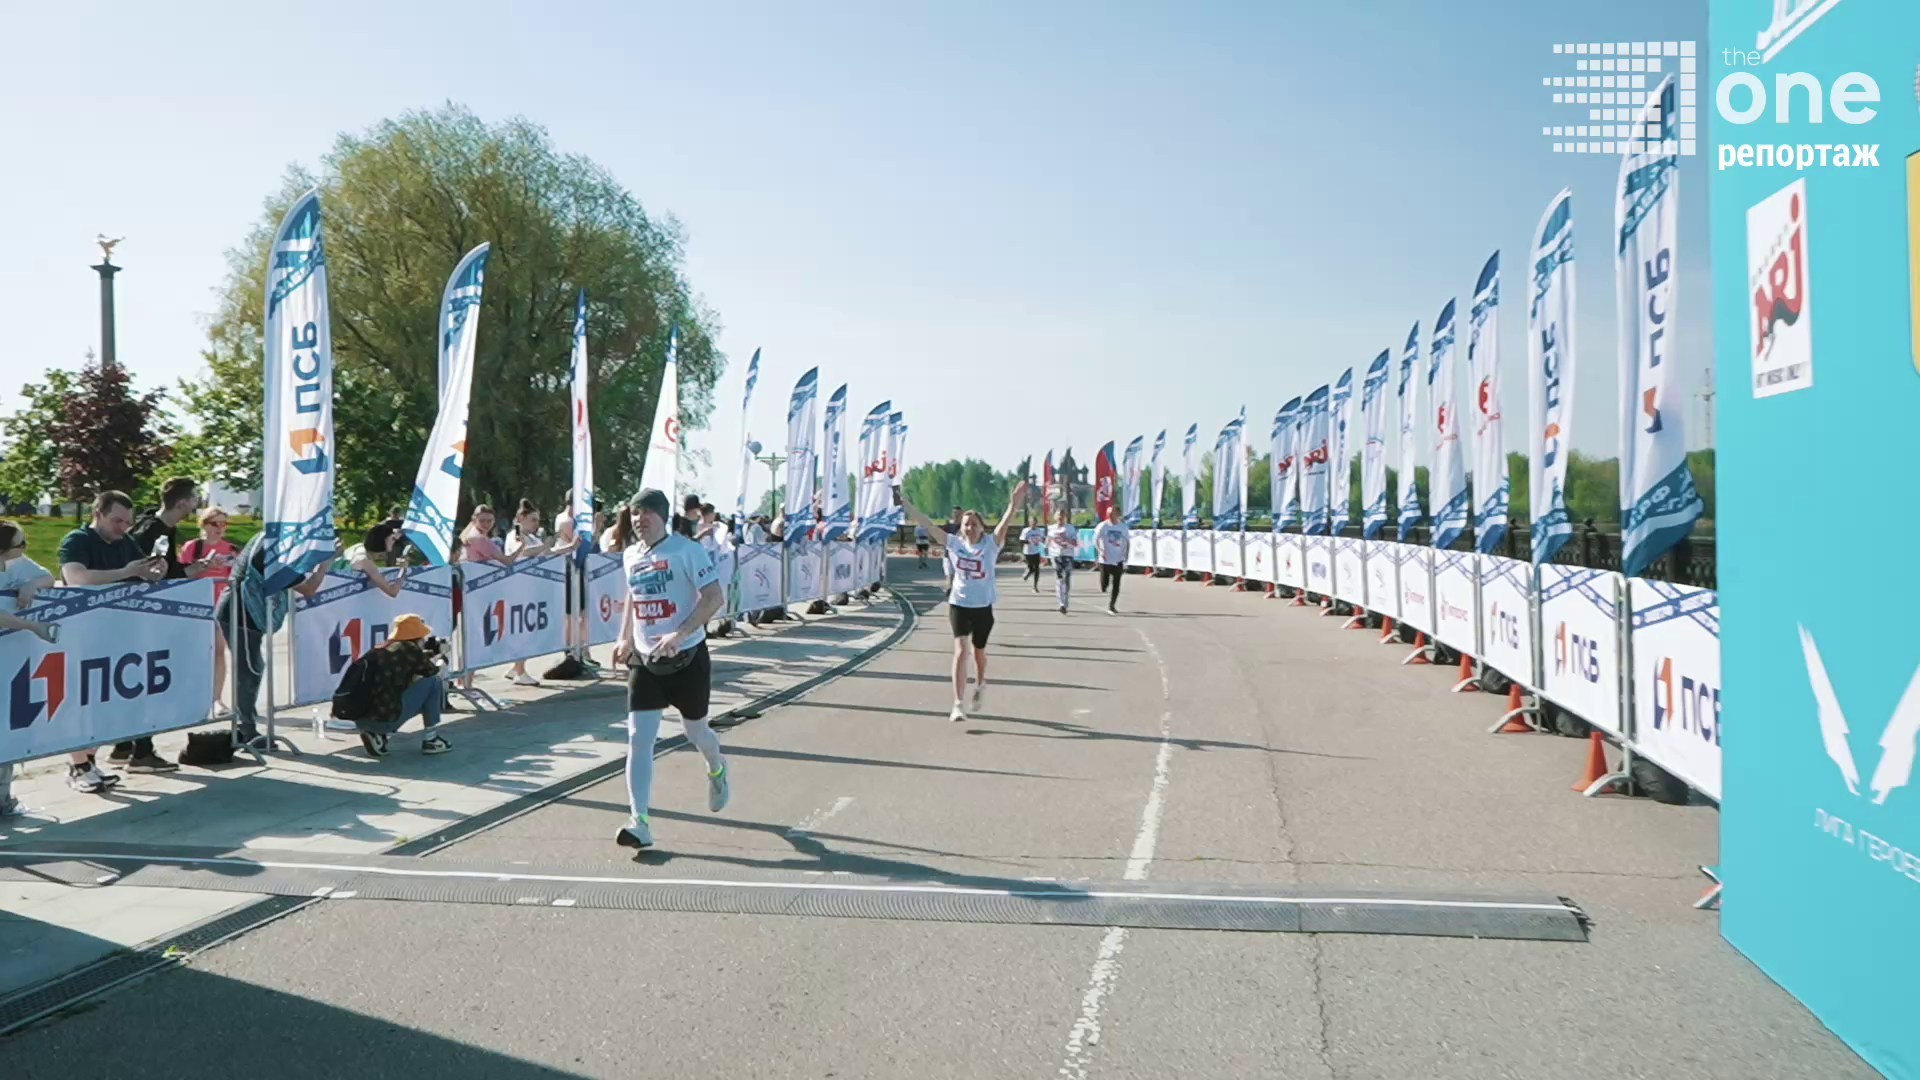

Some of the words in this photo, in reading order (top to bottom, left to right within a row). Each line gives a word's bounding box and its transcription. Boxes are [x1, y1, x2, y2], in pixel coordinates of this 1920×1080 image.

[292, 321, 322, 415] ПСБ
[87, 582, 150, 607] ЗАБЕГ.РФ
[510, 601, 549, 635] ПСБ
[1500, 611, 1519, 650] ПСБ
[81, 649, 172, 706] ПСБ
[1572, 633, 1599, 684] ПСБ
